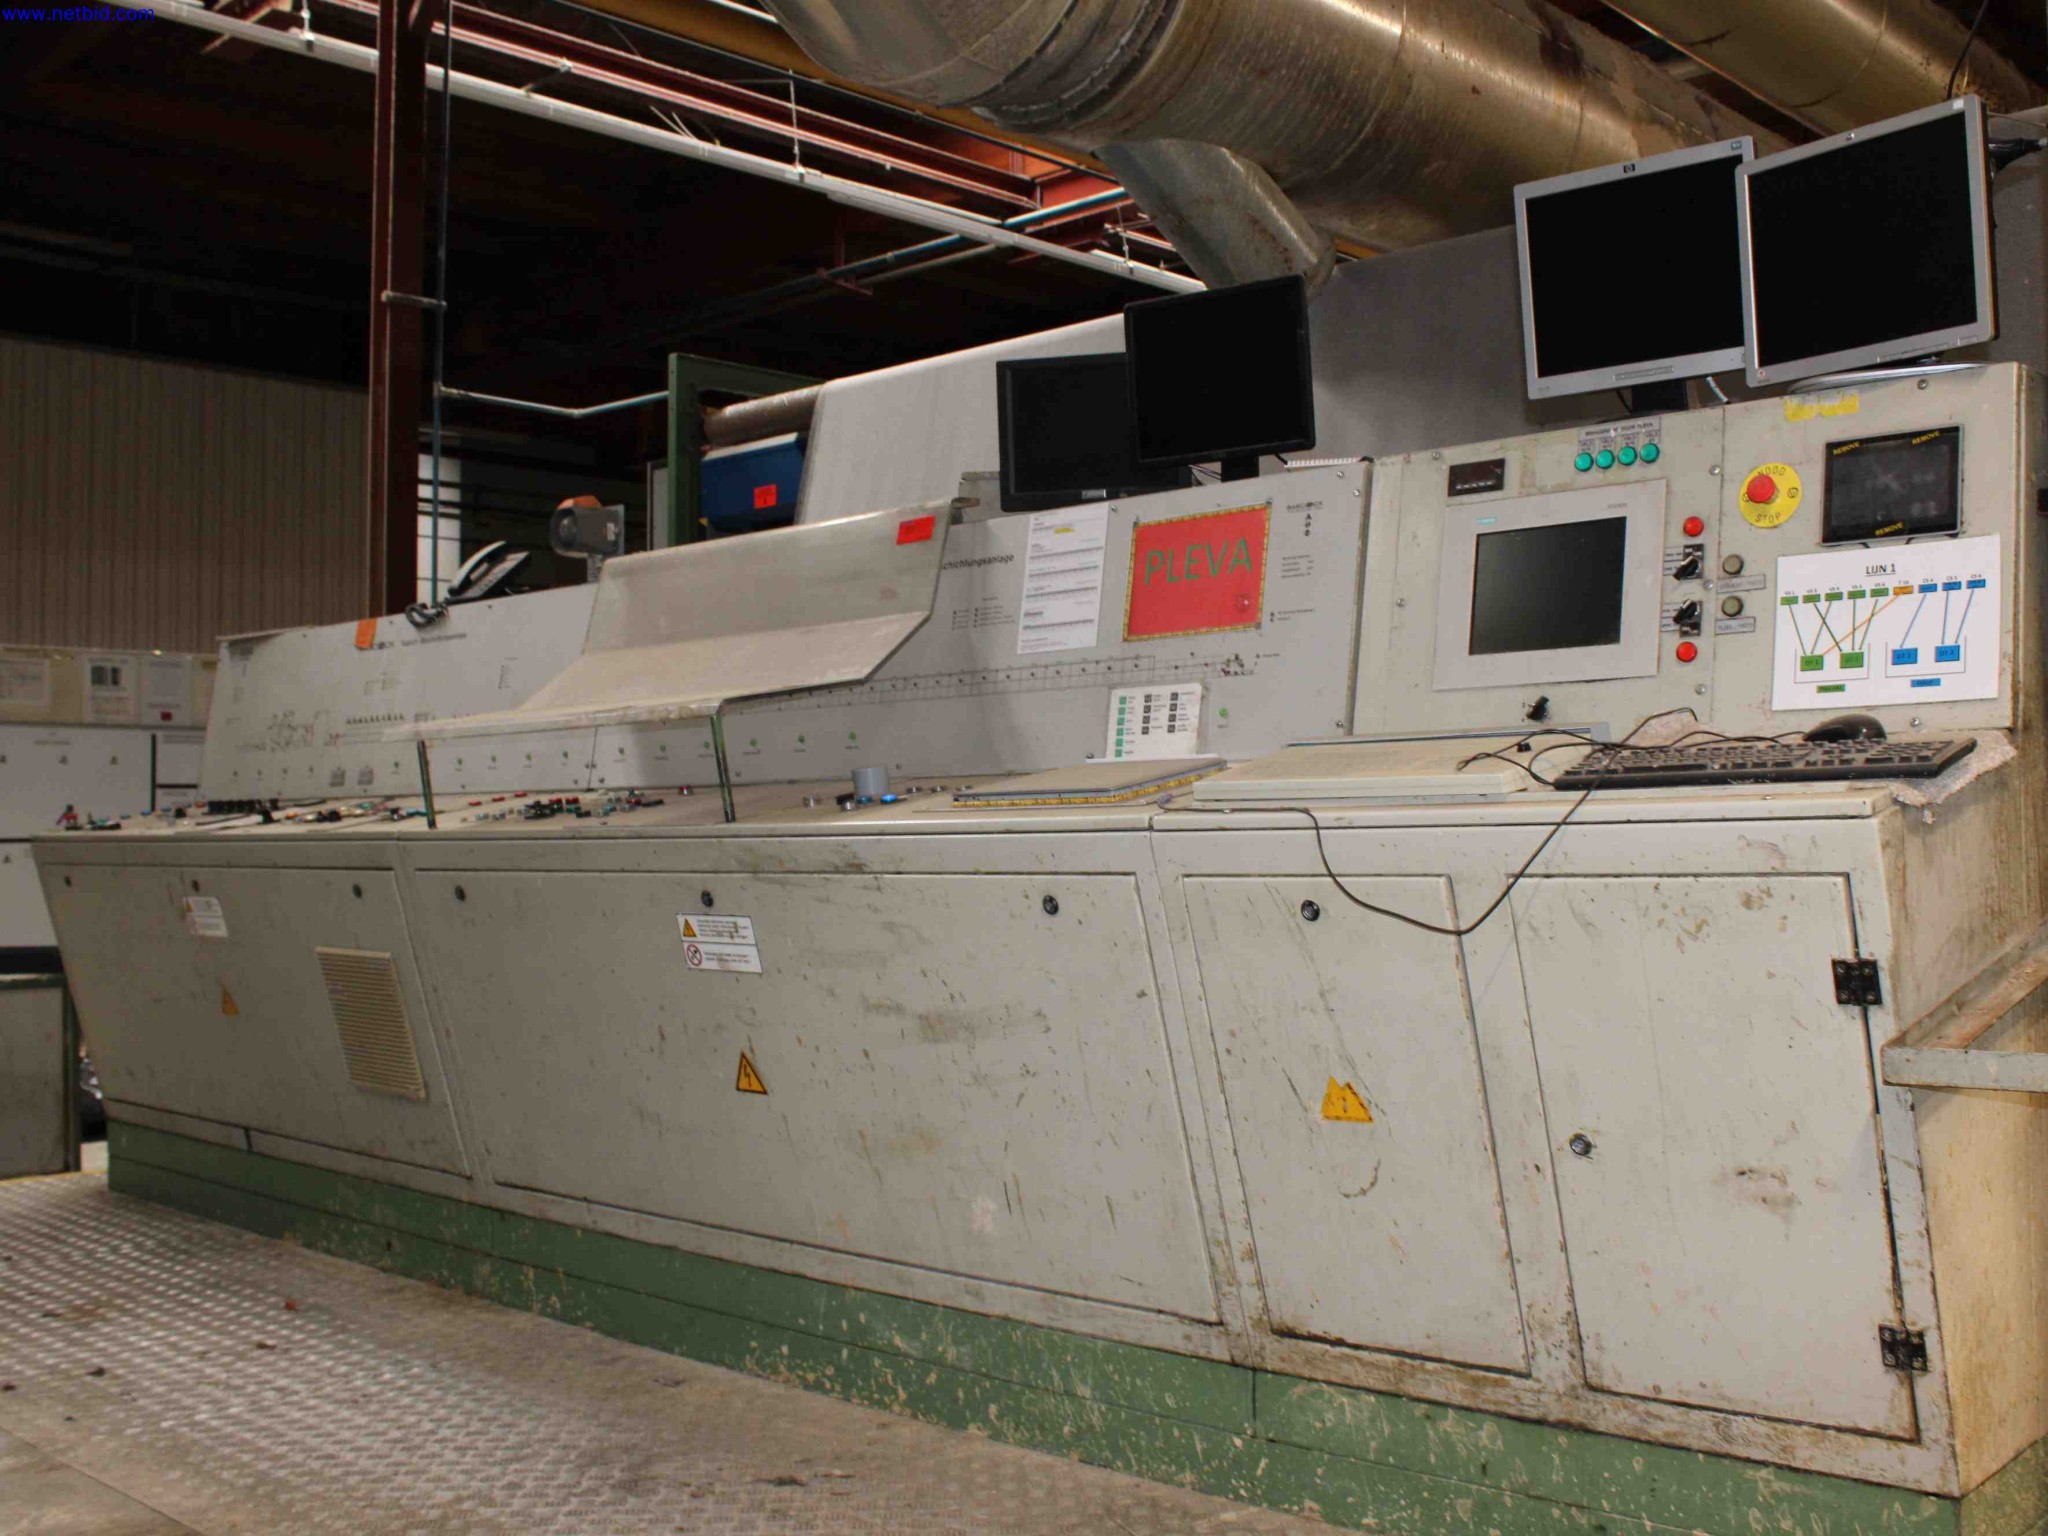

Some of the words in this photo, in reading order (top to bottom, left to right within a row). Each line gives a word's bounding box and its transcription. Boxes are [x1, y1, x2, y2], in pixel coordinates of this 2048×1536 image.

[1911, 431, 1940, 445] REMOVE
[1833, 441, 1860, 455] REMOVE
[1755, 512, 1781, 524] STOP
[1875, 522, 1904, 536] REMOVE
[1144, 537, 1254, 587] PLEVA
